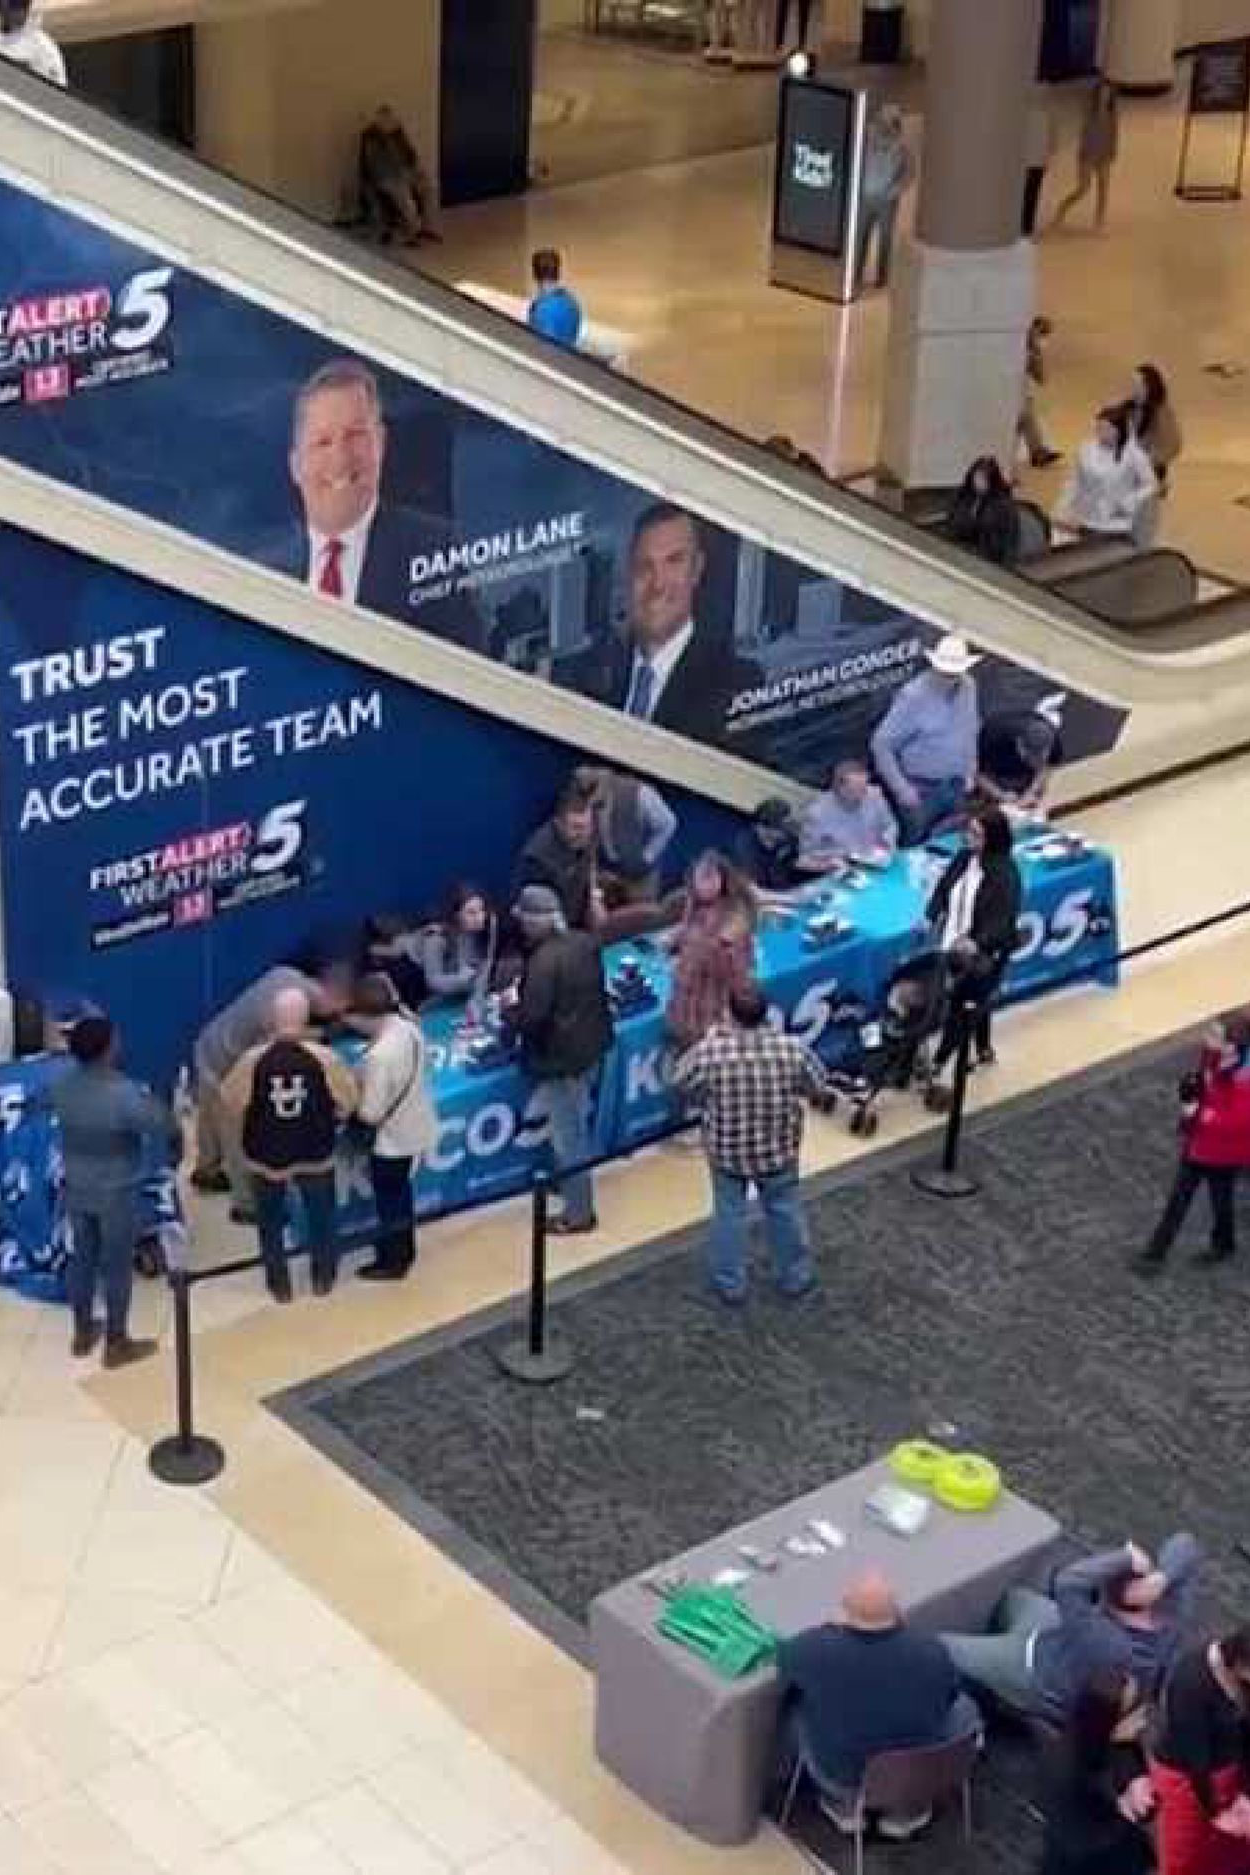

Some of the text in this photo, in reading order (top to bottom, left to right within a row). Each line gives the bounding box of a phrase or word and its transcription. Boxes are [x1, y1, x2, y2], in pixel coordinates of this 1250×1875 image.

[6, 289, 102, 335] ALERT
[109, 267, 174, 348] 5
[409, 530, 510, 583] DAMON
[514, 513, 583, 554] LANE
[9, 626, 166, 702] TRUST
[12, 666, 249, 765] THE MOST
[19, 690, 383, 831] ACCURATE TEAM
[89, 853, 158, 890] FIRST
[251, 799, 307, 872] 5
